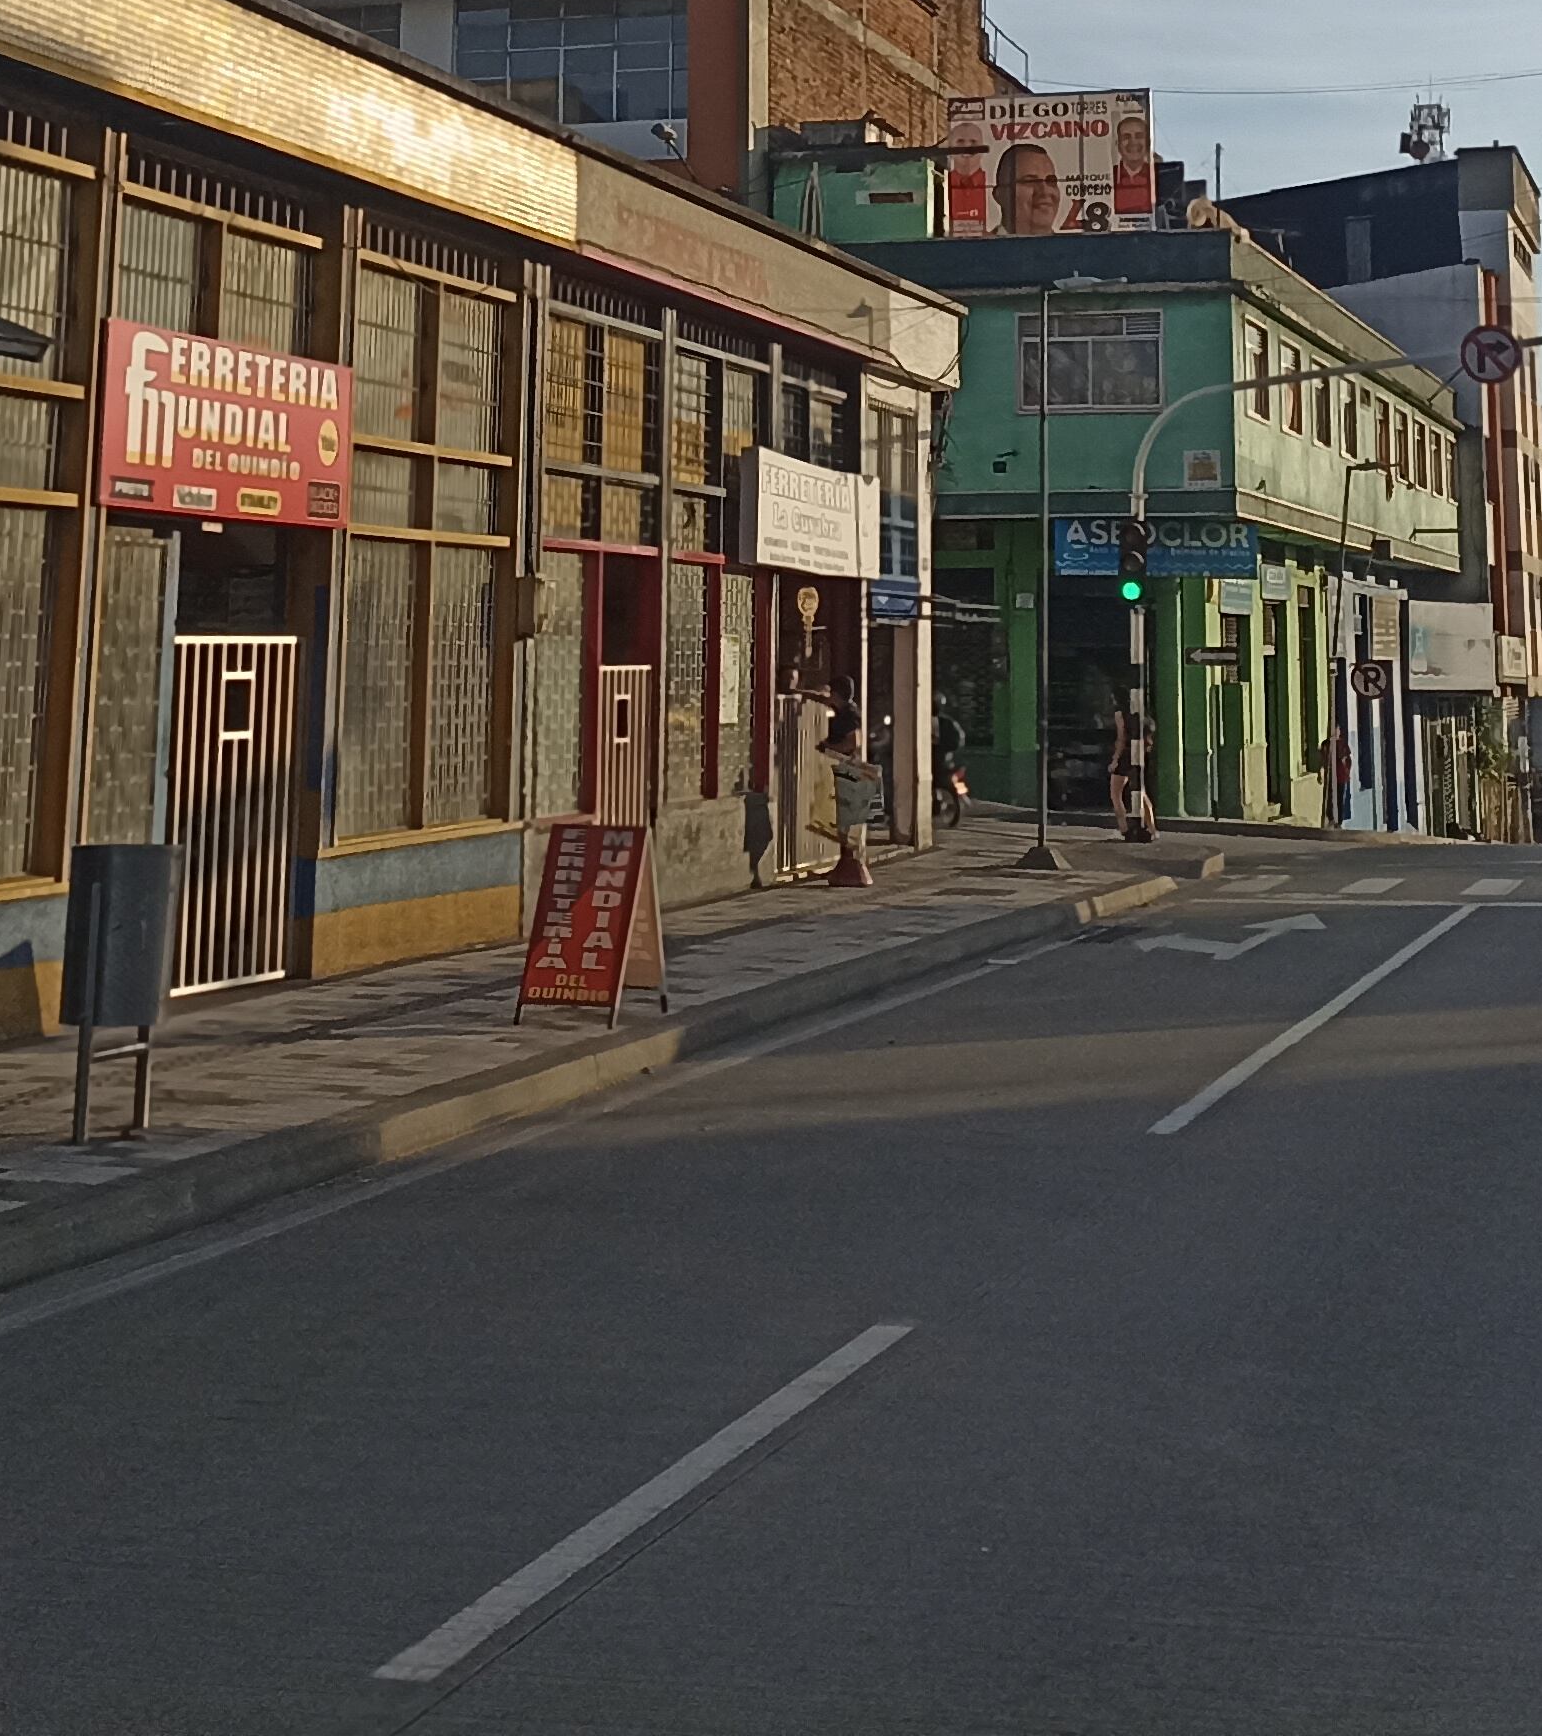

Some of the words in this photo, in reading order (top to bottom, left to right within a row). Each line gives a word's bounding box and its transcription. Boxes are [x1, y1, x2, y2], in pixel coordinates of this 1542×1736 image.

[989, 101, 1070, 120] DIEGO
[989, 119, 1111, 141] VIZCAINO
[127, 330, 339, 411] FERRETERIA
[126, 390, 292, 469] MUNDIAL
[192, 447, 223, 472] DEL
[580, 830, 634, 970] MUNDIAL
[555, 973, 588, 988] DEL
